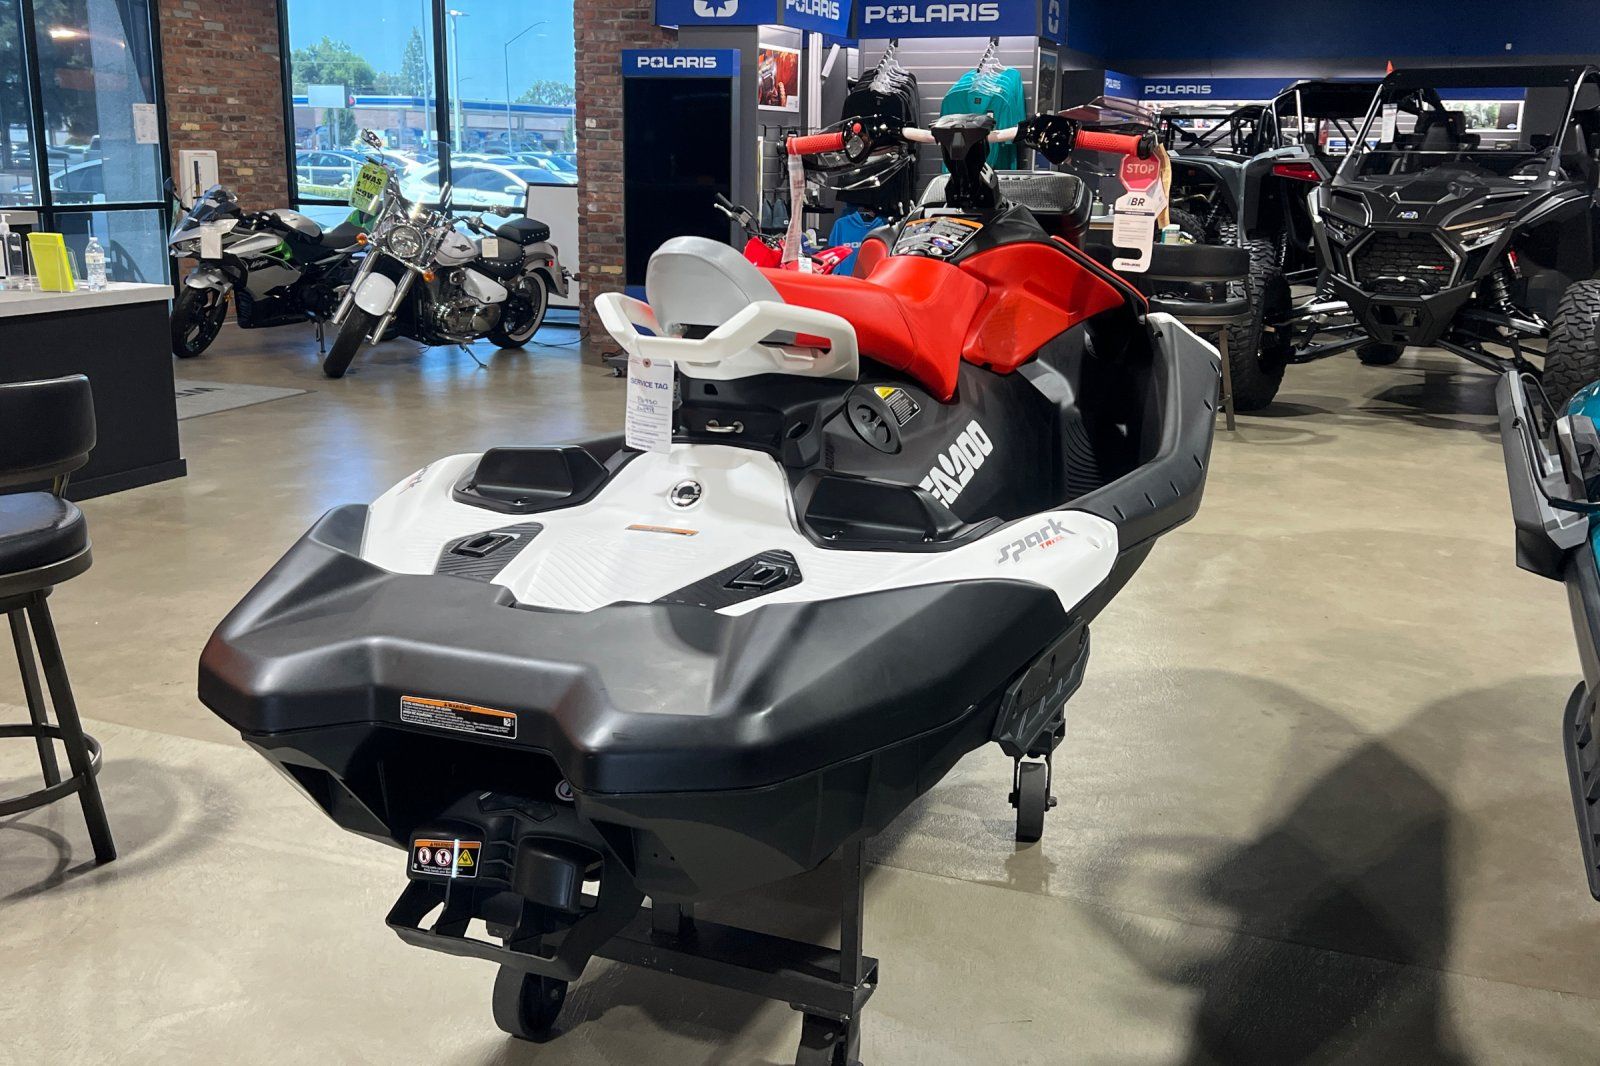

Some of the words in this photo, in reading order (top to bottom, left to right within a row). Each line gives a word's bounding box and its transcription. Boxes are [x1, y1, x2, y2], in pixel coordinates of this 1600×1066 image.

[865, 3, 1000, 24] POLARIS
[637, 56, 717, 69] POLARIS
[1144, 85, 1212, 94] POLARIS
[1126, 163, 1155, 174] STOP
[362, 172, 382, 185] WAS
[630, 377, 653, 389] SERVICE
[655, 382, 669, 391] TAG
